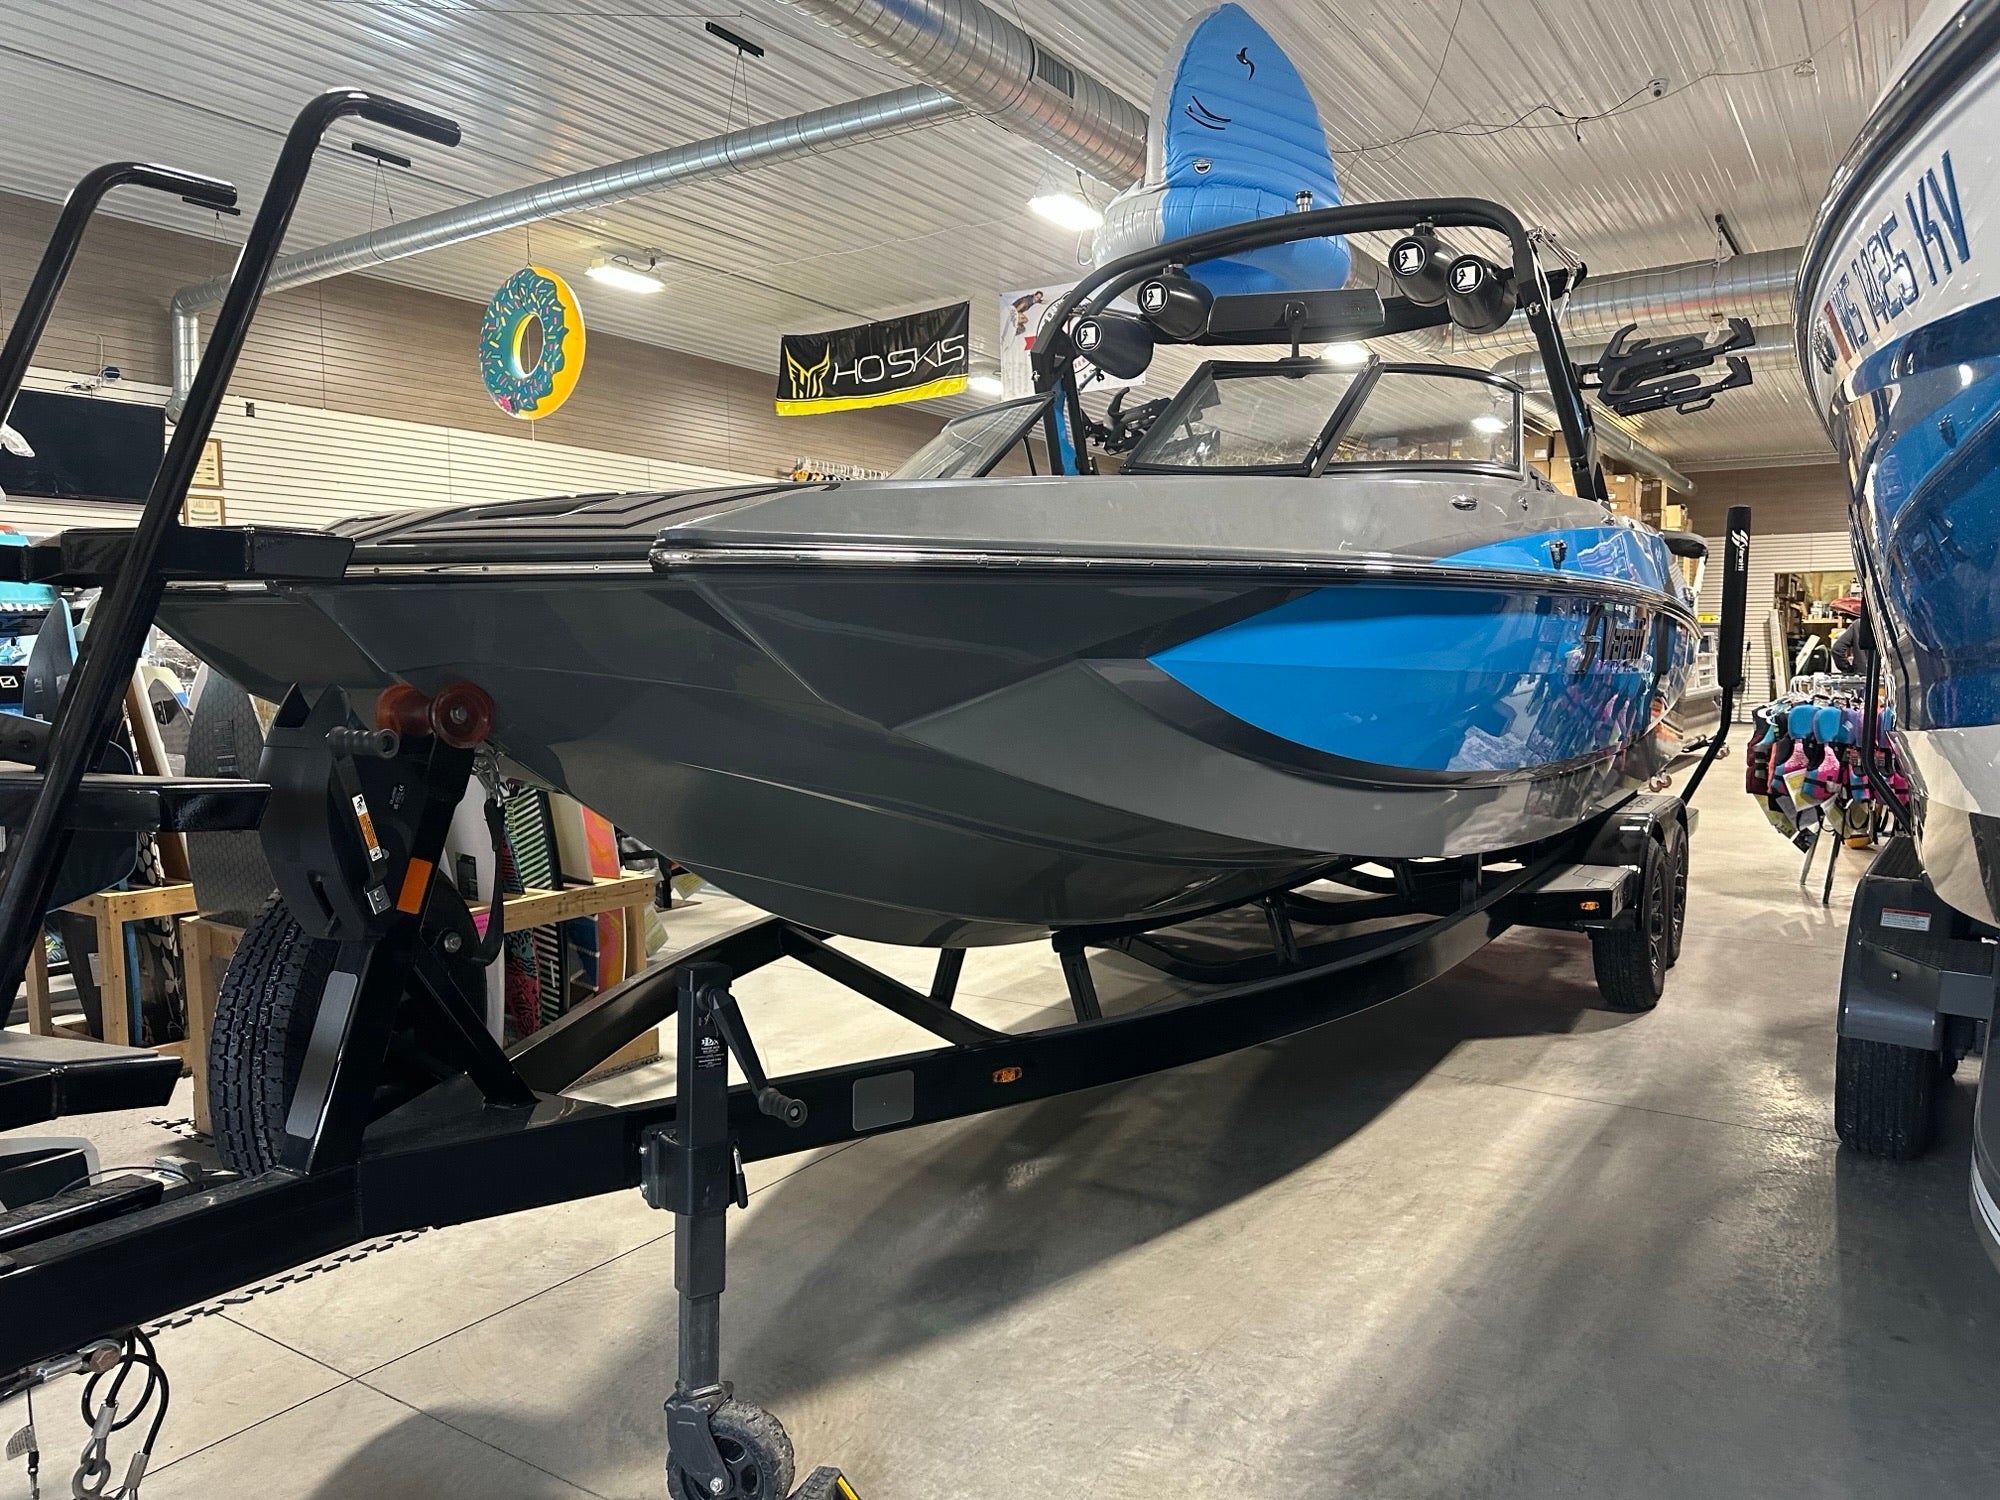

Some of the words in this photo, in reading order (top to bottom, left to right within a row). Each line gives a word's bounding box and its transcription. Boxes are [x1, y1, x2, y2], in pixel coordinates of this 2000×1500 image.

[1851, 211, 1919, 332] 1425
[1905, 150, 1970, 285] KV
[832, 355, 885, 385] HO
[887, 334, 965, 379] SKIS
